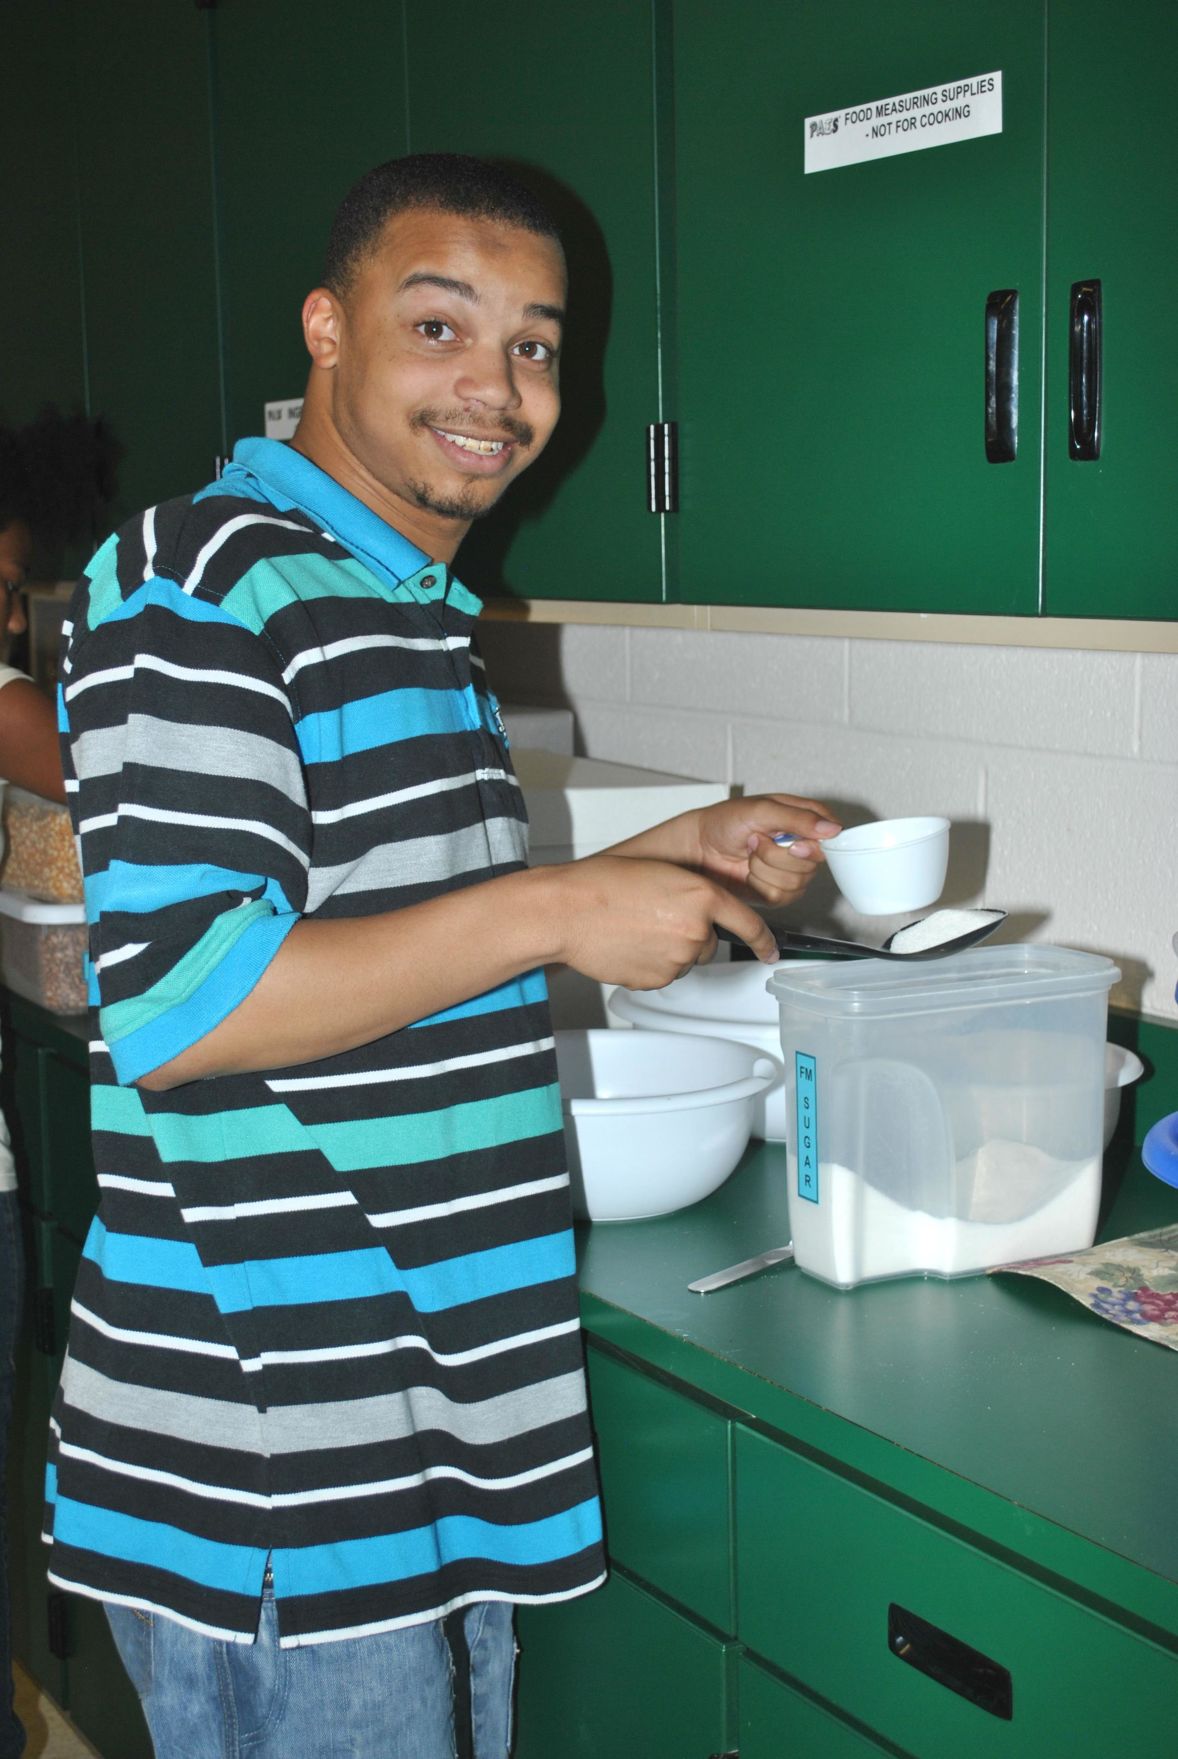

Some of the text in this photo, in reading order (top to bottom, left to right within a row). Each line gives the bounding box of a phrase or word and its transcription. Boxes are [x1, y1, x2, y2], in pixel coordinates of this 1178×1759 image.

[845, 107, 873, 125] FOOD
[875, 92, 937, 116] MEASURING
[941, 78, 994, 101] SUPPLIES
[871, 123, 892, 138] NOT
[895, 117, 916, 133] FOR
[920, 105, 970, 127] COOKING
[800, 1066, 813, 1082] FM
